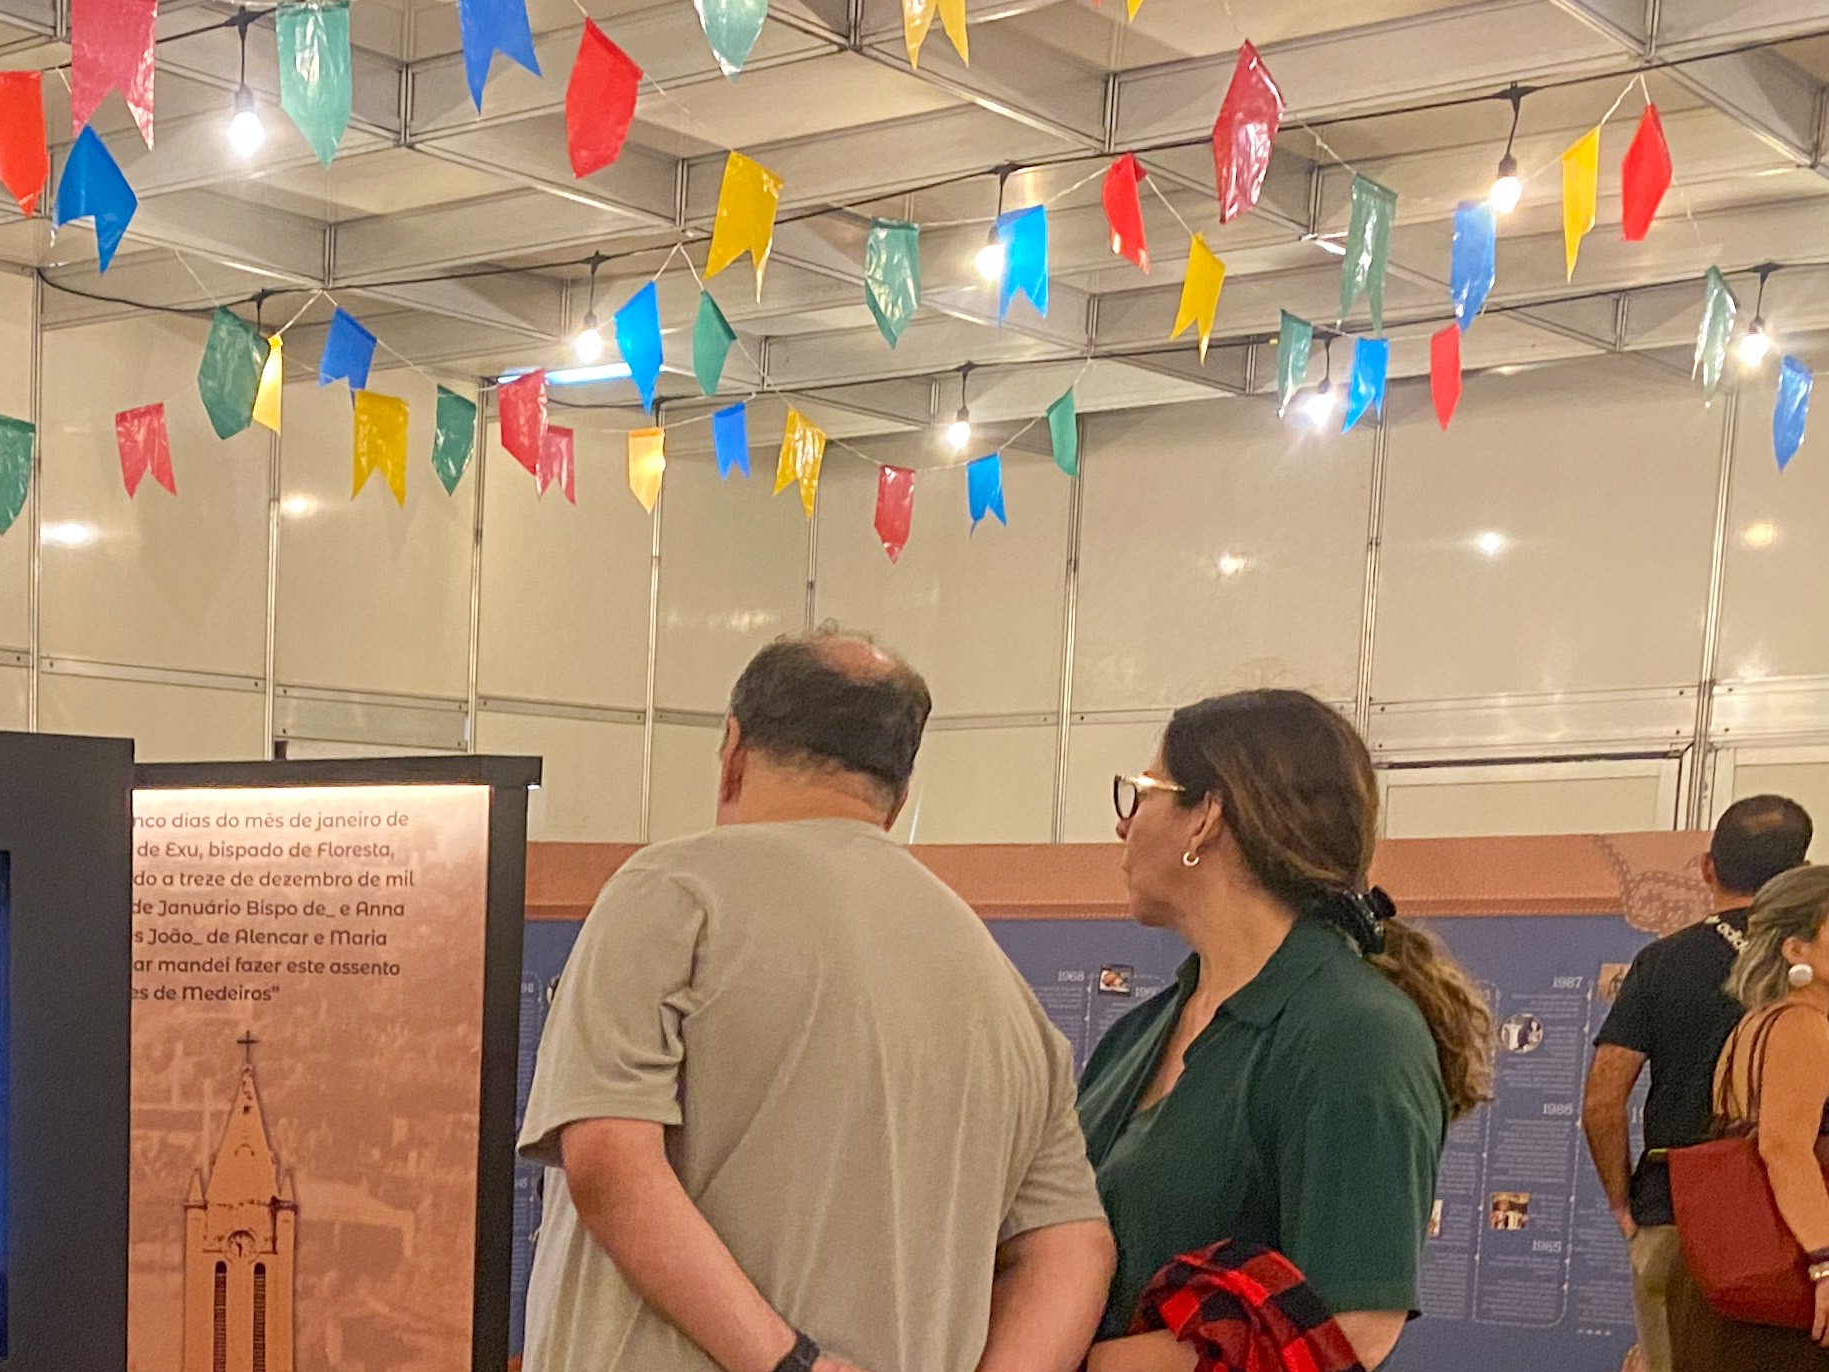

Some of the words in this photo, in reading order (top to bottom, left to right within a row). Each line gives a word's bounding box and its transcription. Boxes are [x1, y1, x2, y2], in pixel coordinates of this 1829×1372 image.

[133, 816, 166, 828] nco
[172, 812, 210, 828] dias
[216, 812, 240, 828] do
[245, 812, 284, 828] mês
[289, 812, 312, 828] de
[314, 810, 382, 832] janeiro
[386, 810, 409, 827] de
[137, 841, 160, 857] de
[165, 842, 204, 860] Exu,
[209, 841, 283, 860] bispado
[289, 842, 312, 858] de
[317, 841, 395, 860] Floresta,
[134, 871, 157, 886] do
[162, 873, 174, 886] a
[180, 872, 225, 887] treze
[231, 871, 254, 886] de
[259, 871, 353, 887] dezembro
[358, 871, 380, 887] de
[385, 869, 415, 887] mil
[157, 899, 241, 917] Januário
[247, 899, 298, 919] Bispo
[340, 903, 350, 916] e
[356, 901, 404, 917] Anna
[207, 928, 230, 944] de
[235, 929, 309, 945] Alencar
[314, 932, 324, 945] e
[330, 929, 387, 946] Maria
[134, 959, 153, 973] ar
[158, 957, 230, 973] mandei
[235, 957, 282, 974] fazer
[287, 960, 325, 974] este
[330, 961, 400, 976] assento
[154, 985, 176, 1001] de
